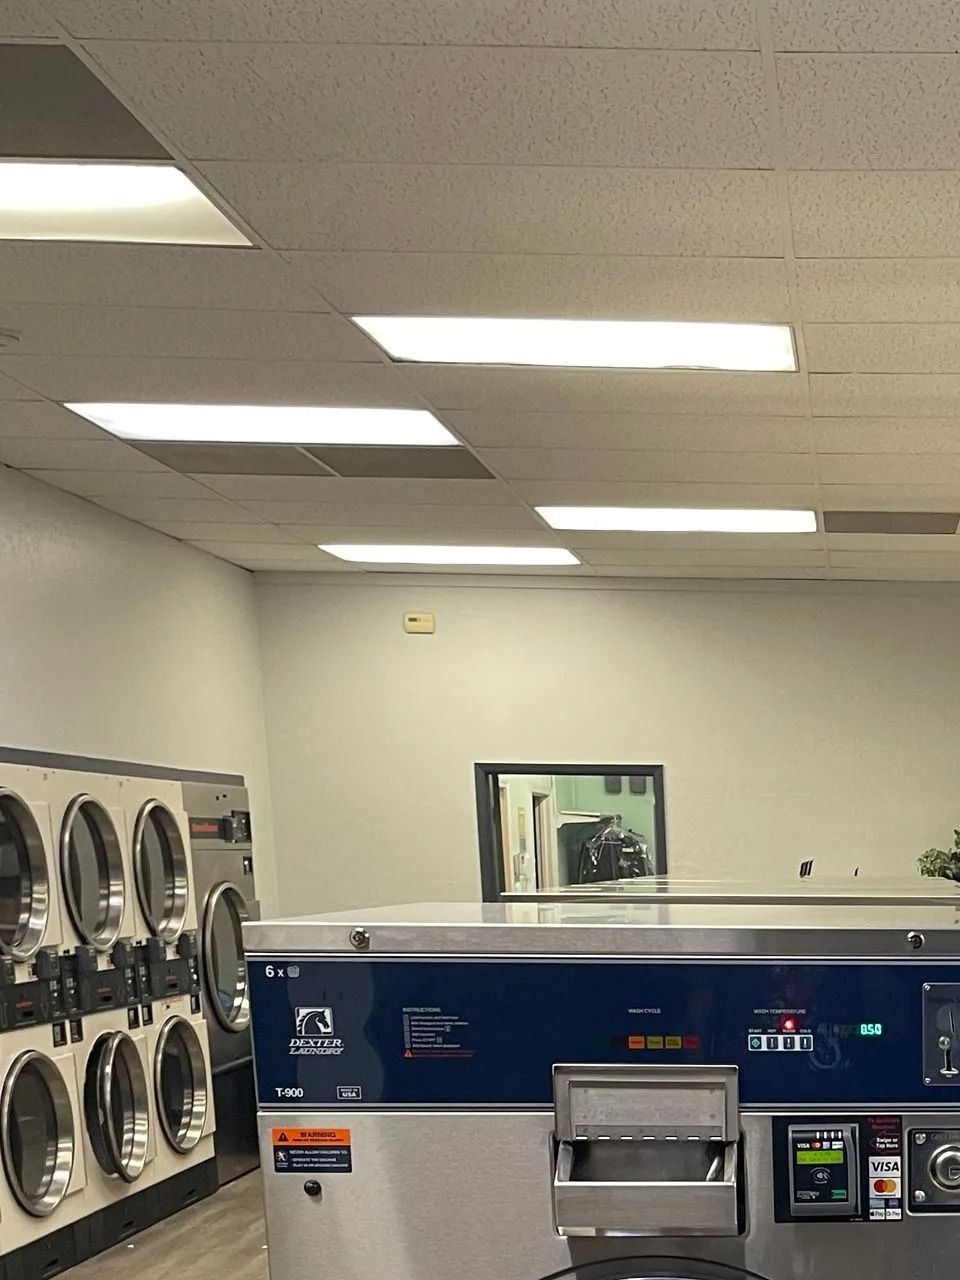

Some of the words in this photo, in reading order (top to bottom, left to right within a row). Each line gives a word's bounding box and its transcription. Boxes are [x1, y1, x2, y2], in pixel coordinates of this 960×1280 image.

[265, 964, 275, 978] 6
[277, 968, 285, 978] x
[289, 1038, 343, 1047] DEXTER
[289, 1047, 344, 1055] LAUNDRY
[275, 1087, 304, 1098] T-900
[871, 1161, 900, 1172] VISA
